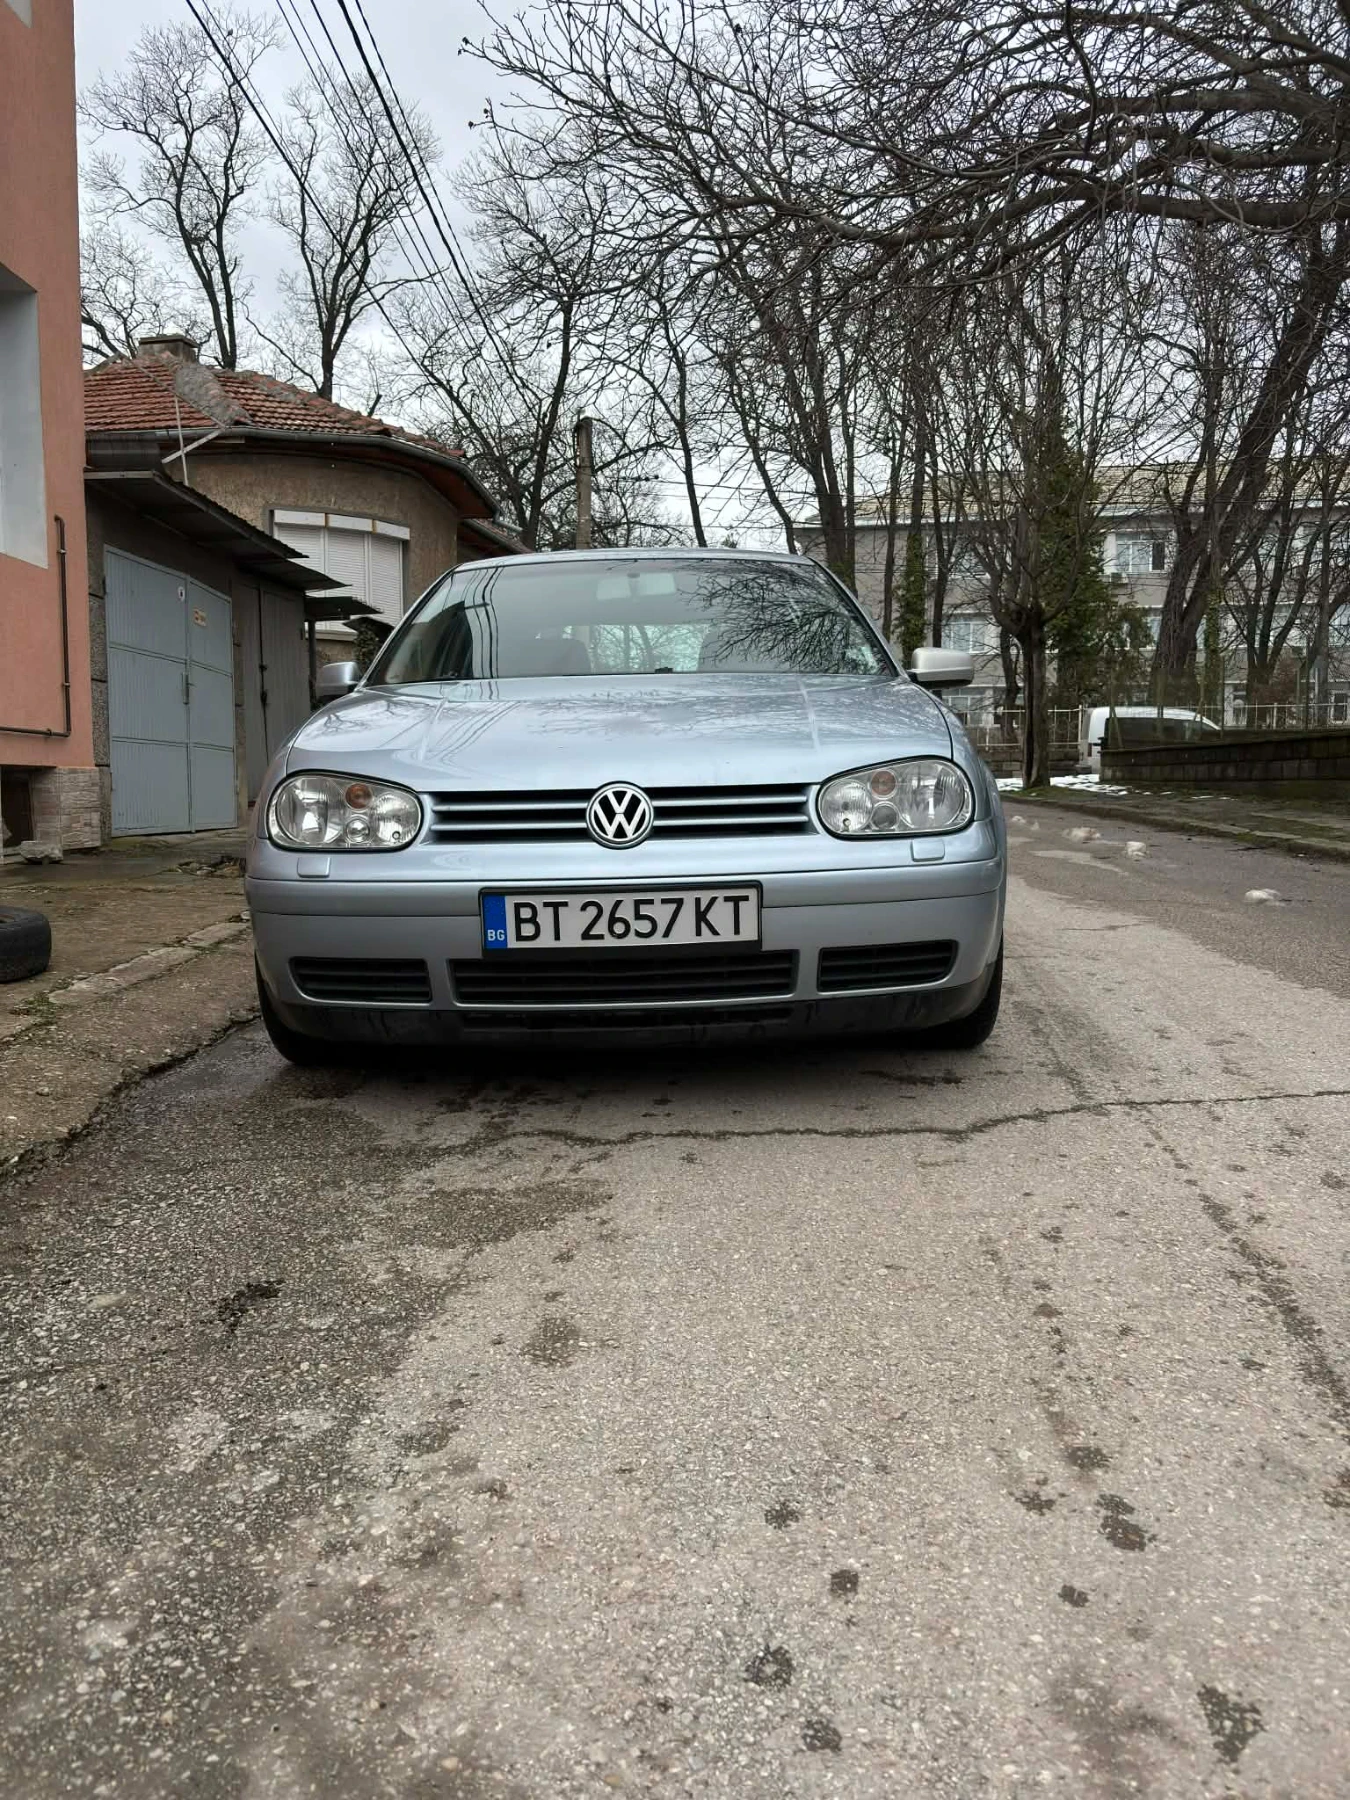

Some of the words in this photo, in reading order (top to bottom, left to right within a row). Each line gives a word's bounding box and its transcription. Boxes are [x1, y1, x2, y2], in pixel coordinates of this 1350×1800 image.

[591, 786, 649, 841] VW
[487, 929, 505, 941] BG
[513, 901, 569, 942] BT
[579, 897, 685, 941] 2657
[694, 894, 750, 937] KT
